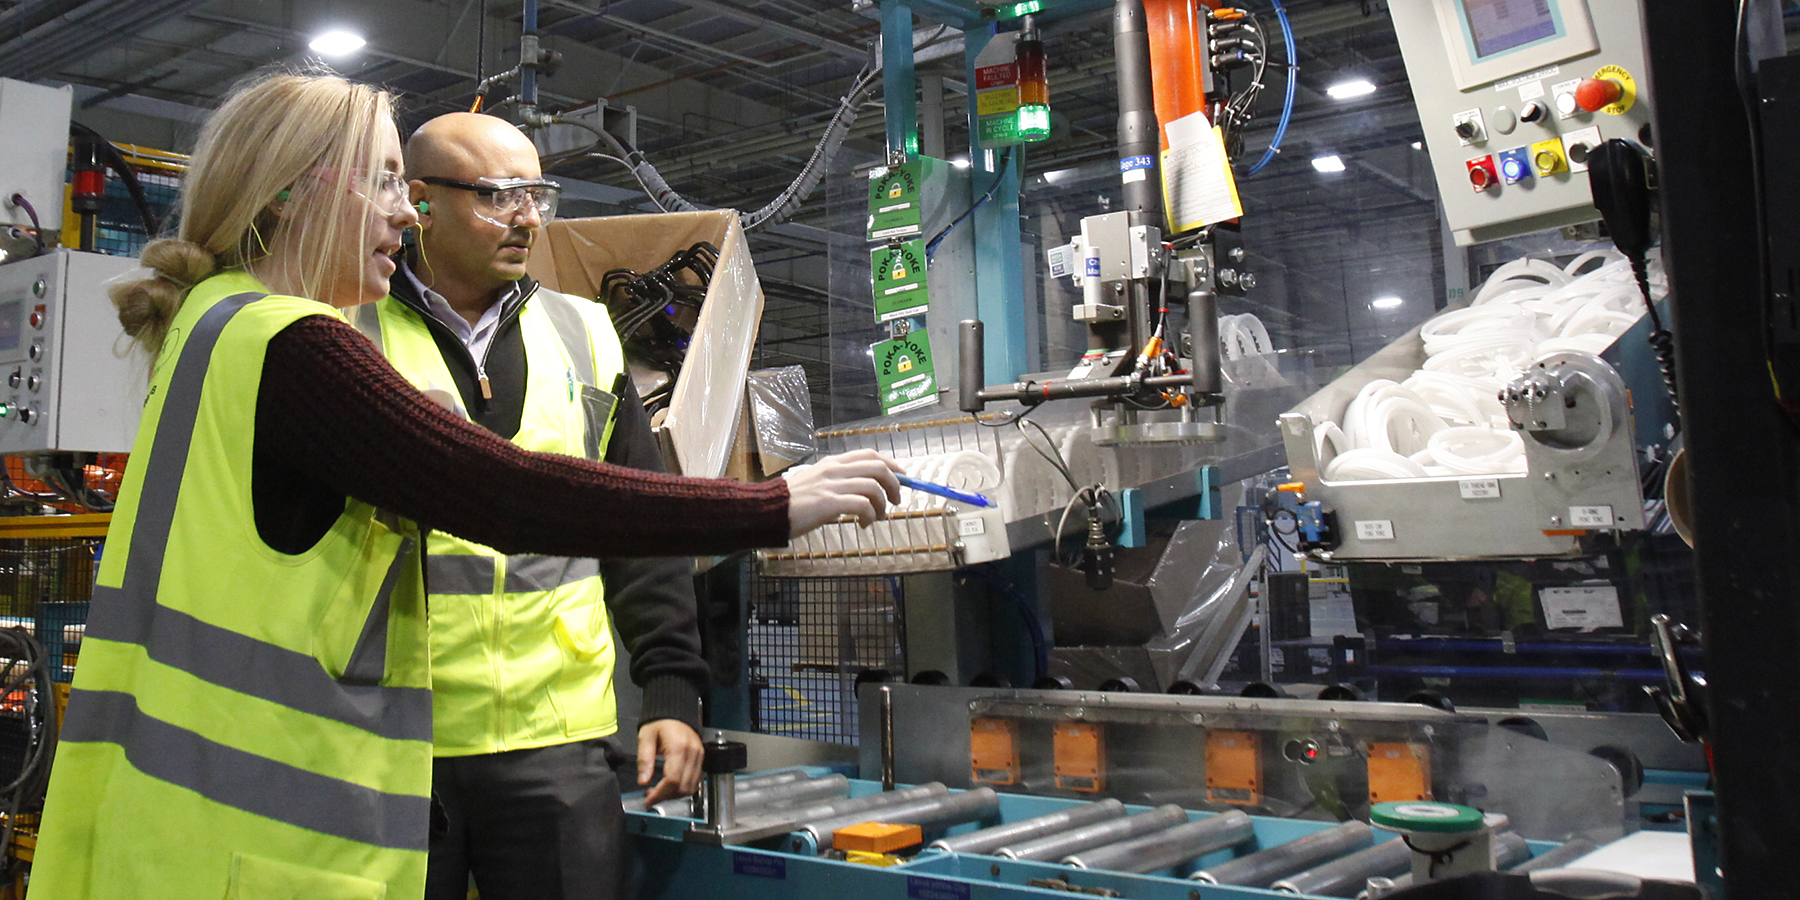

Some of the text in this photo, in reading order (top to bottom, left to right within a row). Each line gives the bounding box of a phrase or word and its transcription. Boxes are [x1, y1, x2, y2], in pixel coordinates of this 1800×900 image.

[983, 65, 1011, 75] MACHINE
[983, 73, 1011, 82] FAULTED
[1606, 105, 1625, 114] STOP
[986, 117, 1014, 126] MACHINE
[993, 124, 1014, 133] CYCLE
[1134, 156, 1151, 166] 343
[875, 169, 915, 199] POKA-YOKE
[883, 340, 927, 376] POKA-YOKE
